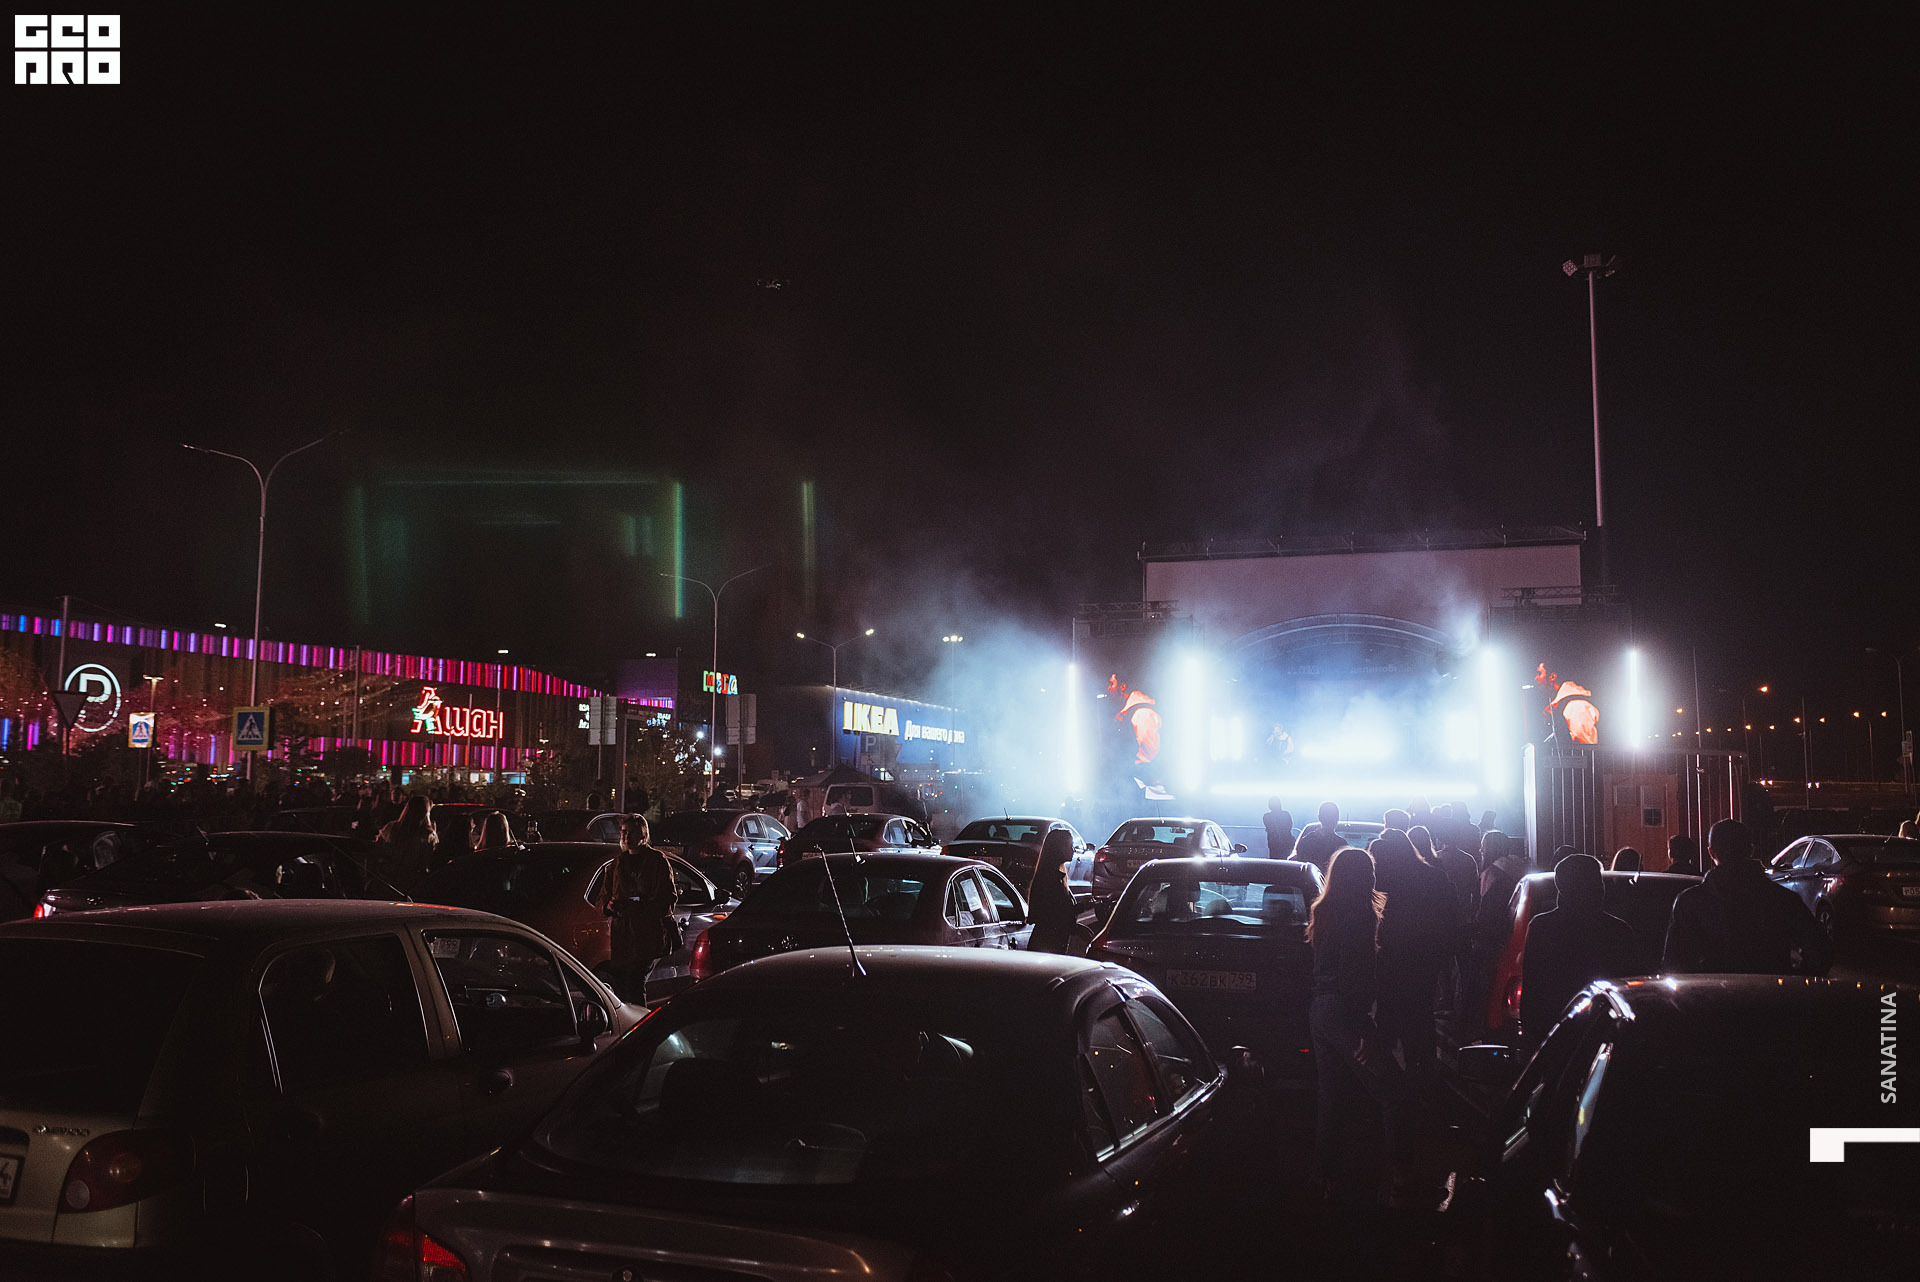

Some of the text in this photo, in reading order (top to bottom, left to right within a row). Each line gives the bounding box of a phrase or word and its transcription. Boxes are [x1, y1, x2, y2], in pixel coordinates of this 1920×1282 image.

[409, 686, 504, 739] Ашан
[842, 701, 900, 736] IKEA
[904, 720, 965, 745] Для вашего дма
